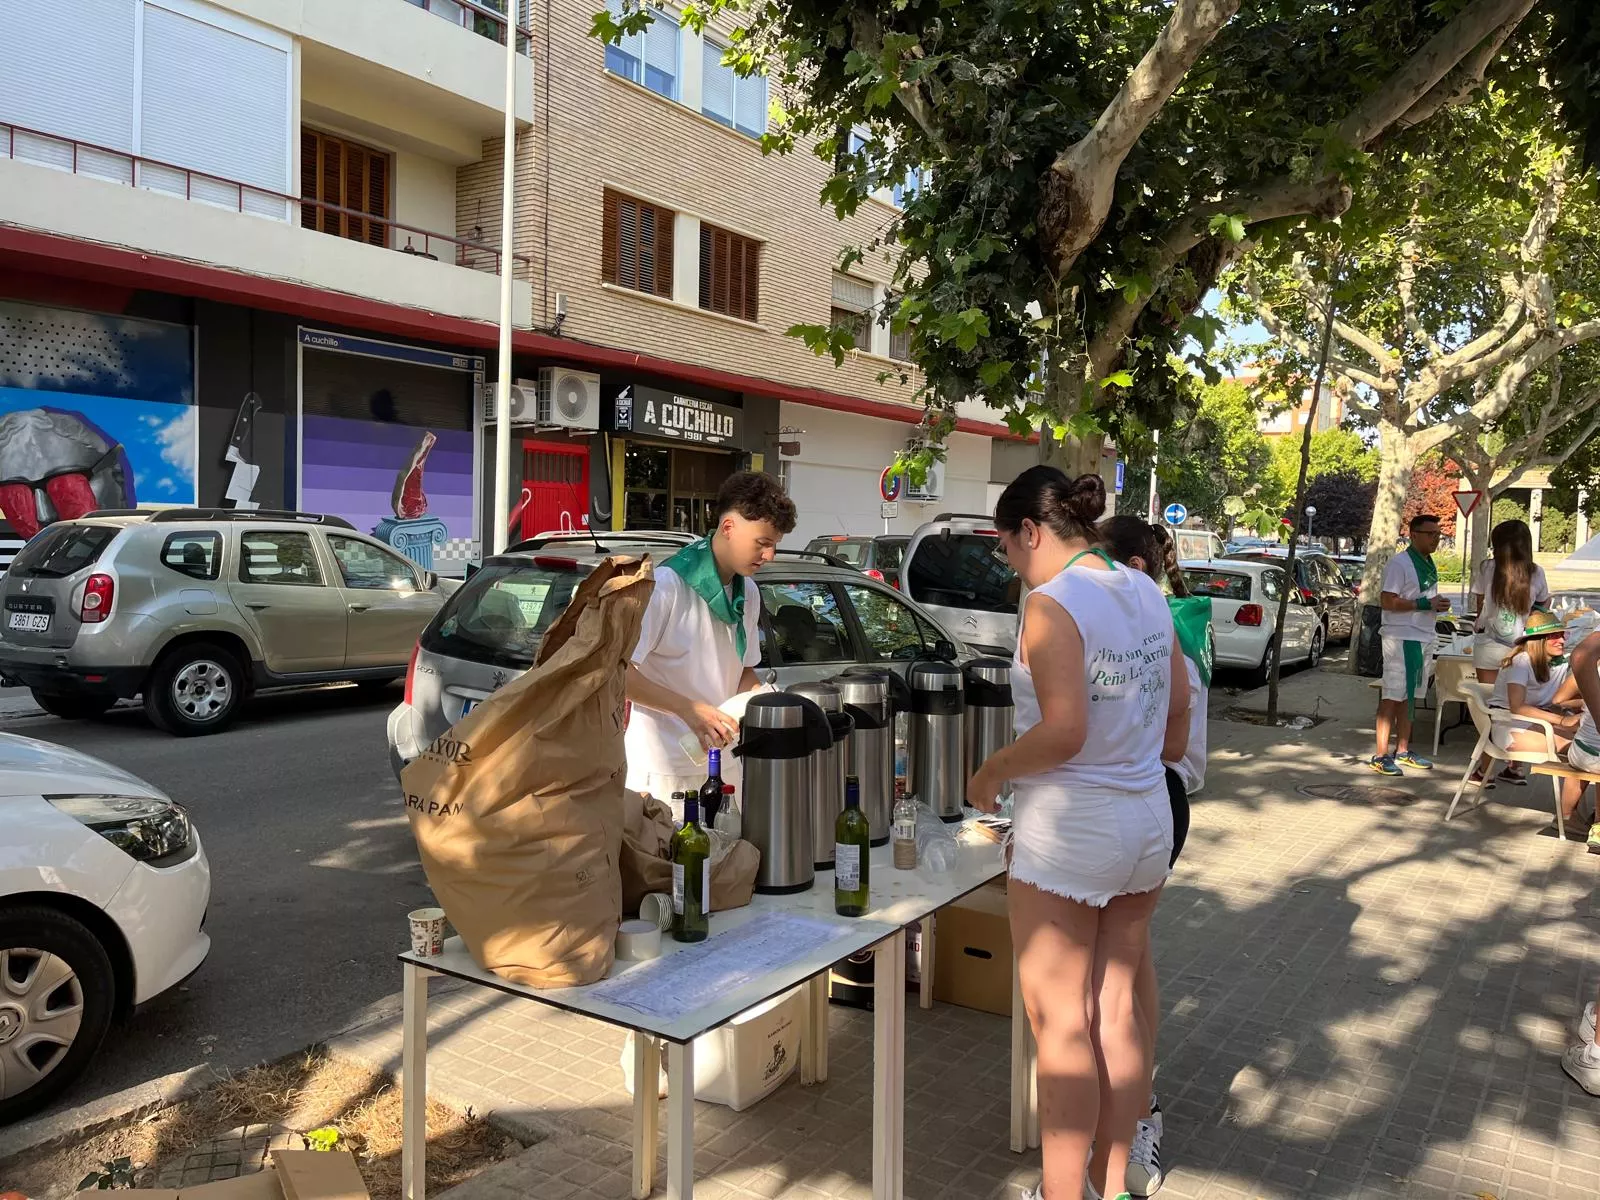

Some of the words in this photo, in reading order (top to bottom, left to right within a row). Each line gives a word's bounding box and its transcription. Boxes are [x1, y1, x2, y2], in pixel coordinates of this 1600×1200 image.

[304, 334, 310, 342] A
[312, 337, 338, 346] cuchillo
[644, 400, 657, 424] A
[661, 403, 734, 438] CUCHILLO
[684, 430, 703, 441] 1981
[15, 615, 30, 626] 5861
[33, 616, 47, 628] GZS
[1125, 648, 1143, 662] San
[1142, 632, 1165, 646] renzo
[1091, 670, 1126, 687] Peña
[1143, 645, 1169, 664] arrill
[428, 800, 464, 816] PAN
